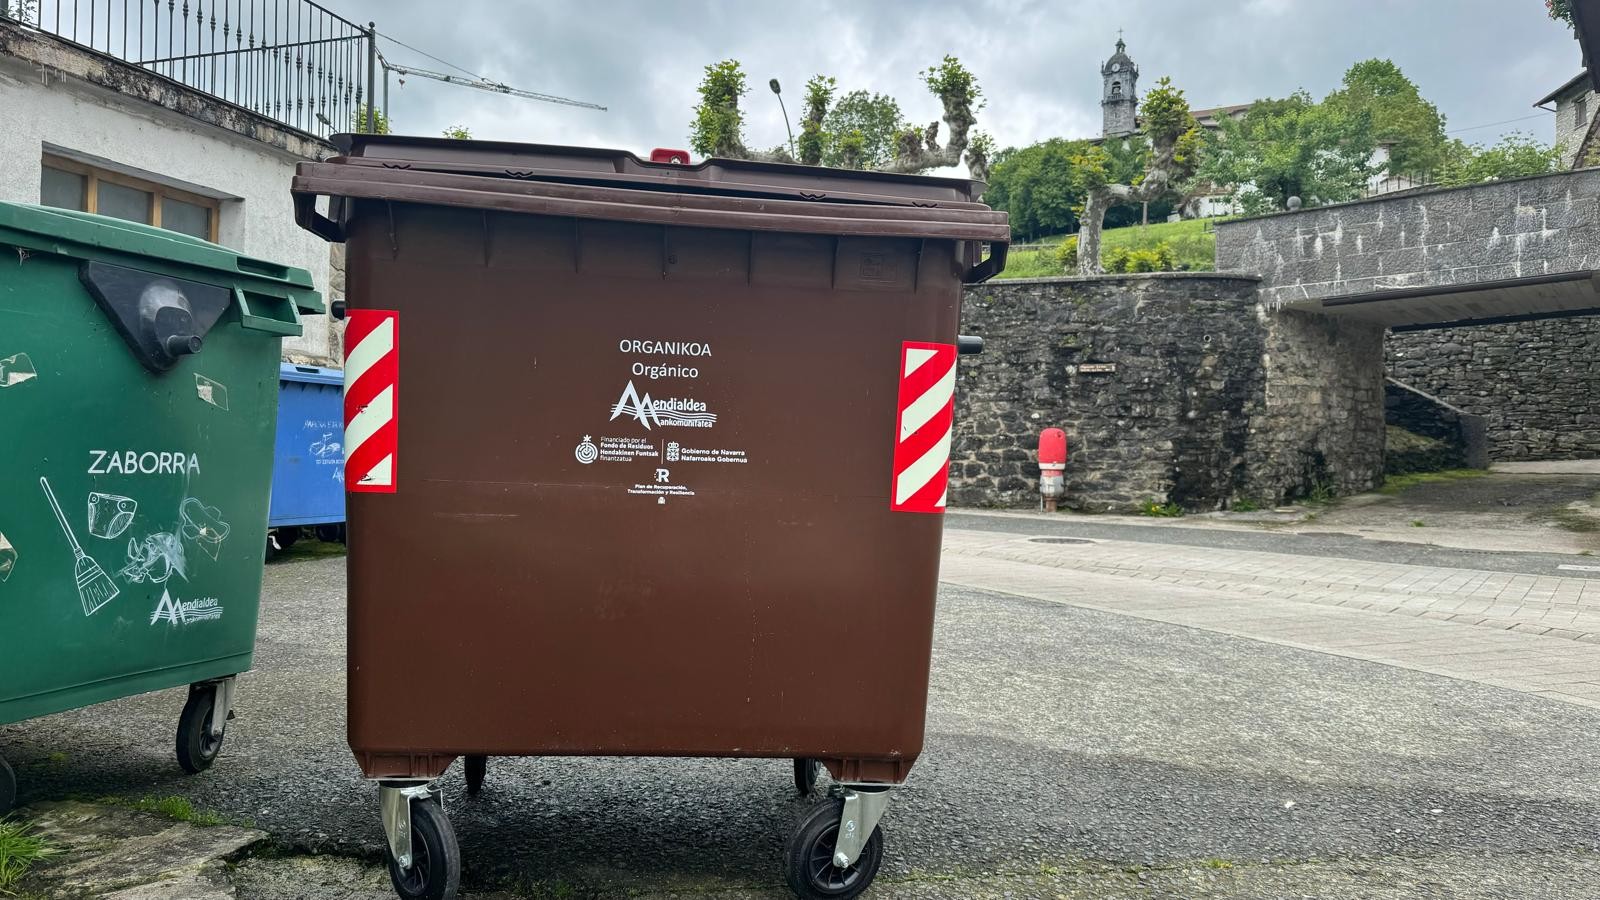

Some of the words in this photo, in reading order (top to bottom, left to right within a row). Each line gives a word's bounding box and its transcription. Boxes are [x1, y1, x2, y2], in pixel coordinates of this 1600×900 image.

[619, 339, 712, 357] ORGANIKOA
[632, 362, 699, 380] Orgánico
[600, 436, 631, 444] Financiado
[87, 450, 201, 474] ZABORRA
[716, 456, 748, 464] Gobernua
[654, 468, 670, 483] R
